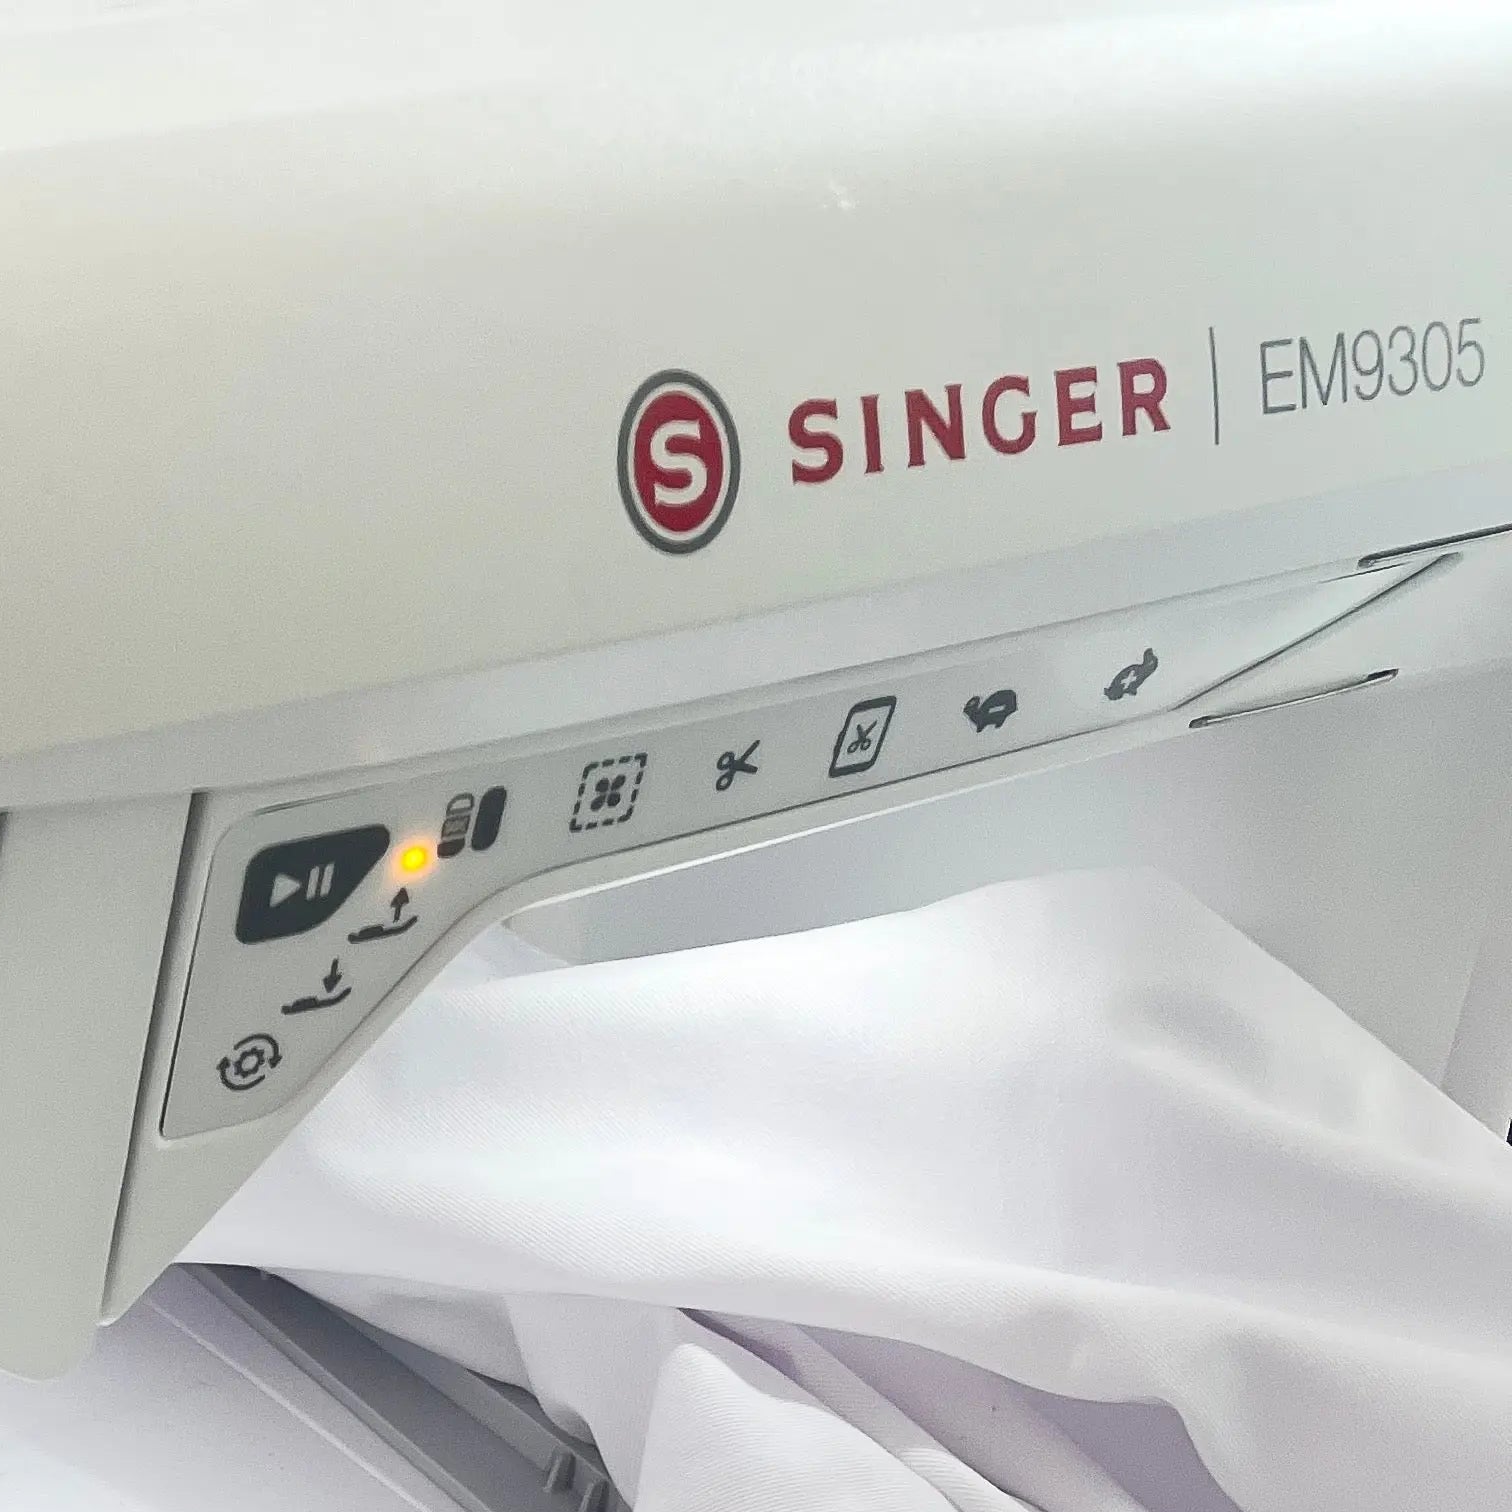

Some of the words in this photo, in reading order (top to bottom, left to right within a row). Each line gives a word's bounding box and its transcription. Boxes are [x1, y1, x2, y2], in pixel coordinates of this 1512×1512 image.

[649, 419, 708, 506] S
[787, 358, 1171, 486] SINGER
[1259, 317, 1486, 416] EM9305
